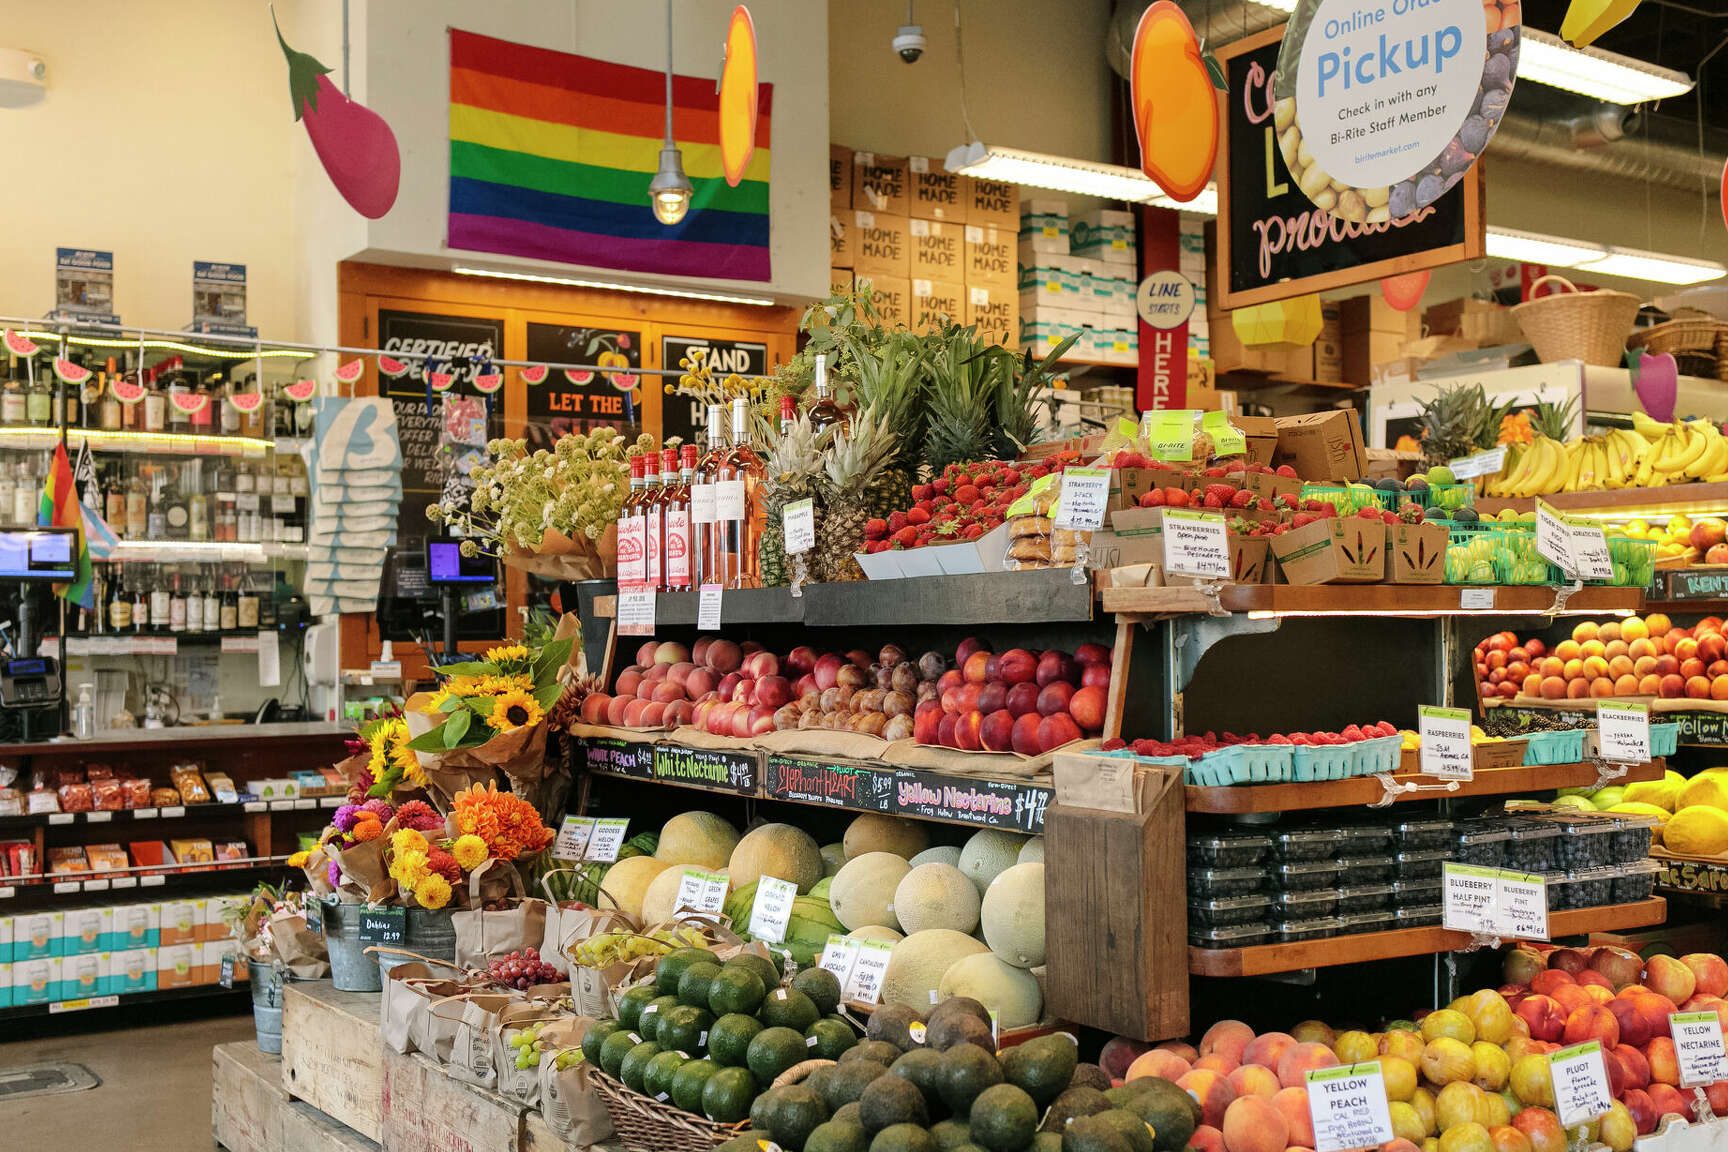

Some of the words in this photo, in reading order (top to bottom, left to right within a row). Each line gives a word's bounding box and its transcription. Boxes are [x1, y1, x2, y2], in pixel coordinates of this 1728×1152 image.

[1324, 7, 1385, 40] Online
[1317, 25, 1463, 98] Pickup
[1338, 103, 1371, 121] Check
[1374, 97, 1385, 110] in
[1388, 90, 1413, 106] with
[1417, 84, 1438, 98] any
[1330, 125, 1366, 145] Bi-Rite
[1369, 116, 1396, 134] Staff
[1398, 104, 1447, 126] Member
[1354, 139, 1420, 164] biritemarket.com
[864, 166, 903, 183] HOME
[919, 173, 958, 189] HOME
[919, 188, 958, 205] MADE
[975, 180, 1011, 197] HOME
[975, 197, 1011, 213] MADE
[863, 228, 902, 244] HOME
[918, 235, 956, 251] HOME
[863, 243, 902, 260] MADE
[919, 250, 956, 267] MADE
[973, 243, 1009, 258] HOME
[973, 258, 1009, 274] MADE
[1149, 283, 1182, 297] LINE
[920, 297, 957, 311] HOME
[1148, 303, 1181, 315] STARTS
[685, 346, 750, 373] STAND
[549, 391, 584, 412] LET
[589, 394, 623, 415] THE
[1168, 523, 1220, 535] STRAWBERRIES
[1602, 713, 1645, 723] BLACKBERRIES
[1427, 728, 1465, 740] RASPBERRIES
[610, 750, 636, 768] PEACH
[656, 752, 687, 777] White
[686, 754, 729, 784] Nectarine
[897, 781, 942, 807] Yellow
[943, 786, 1013, 816] Nectarine
[1450, 878, 1493, 890] BLUEBERRY
[1503, 886, 1538, 897] BLUEBERRY
[1453, 892, 1473, 902] HALF
[1473, 894, 1492, 904] PINT
[1683, 1025, 1711, 1035] YELLOW
[1680, 1039, 1721, 1051] NECTARINE
[1565, 1061, 1590, 1076] PLUOT
[1323, 1078, 1368, 1094] YELLOW
[1330, 1095, 1368, 1110] PEACH
